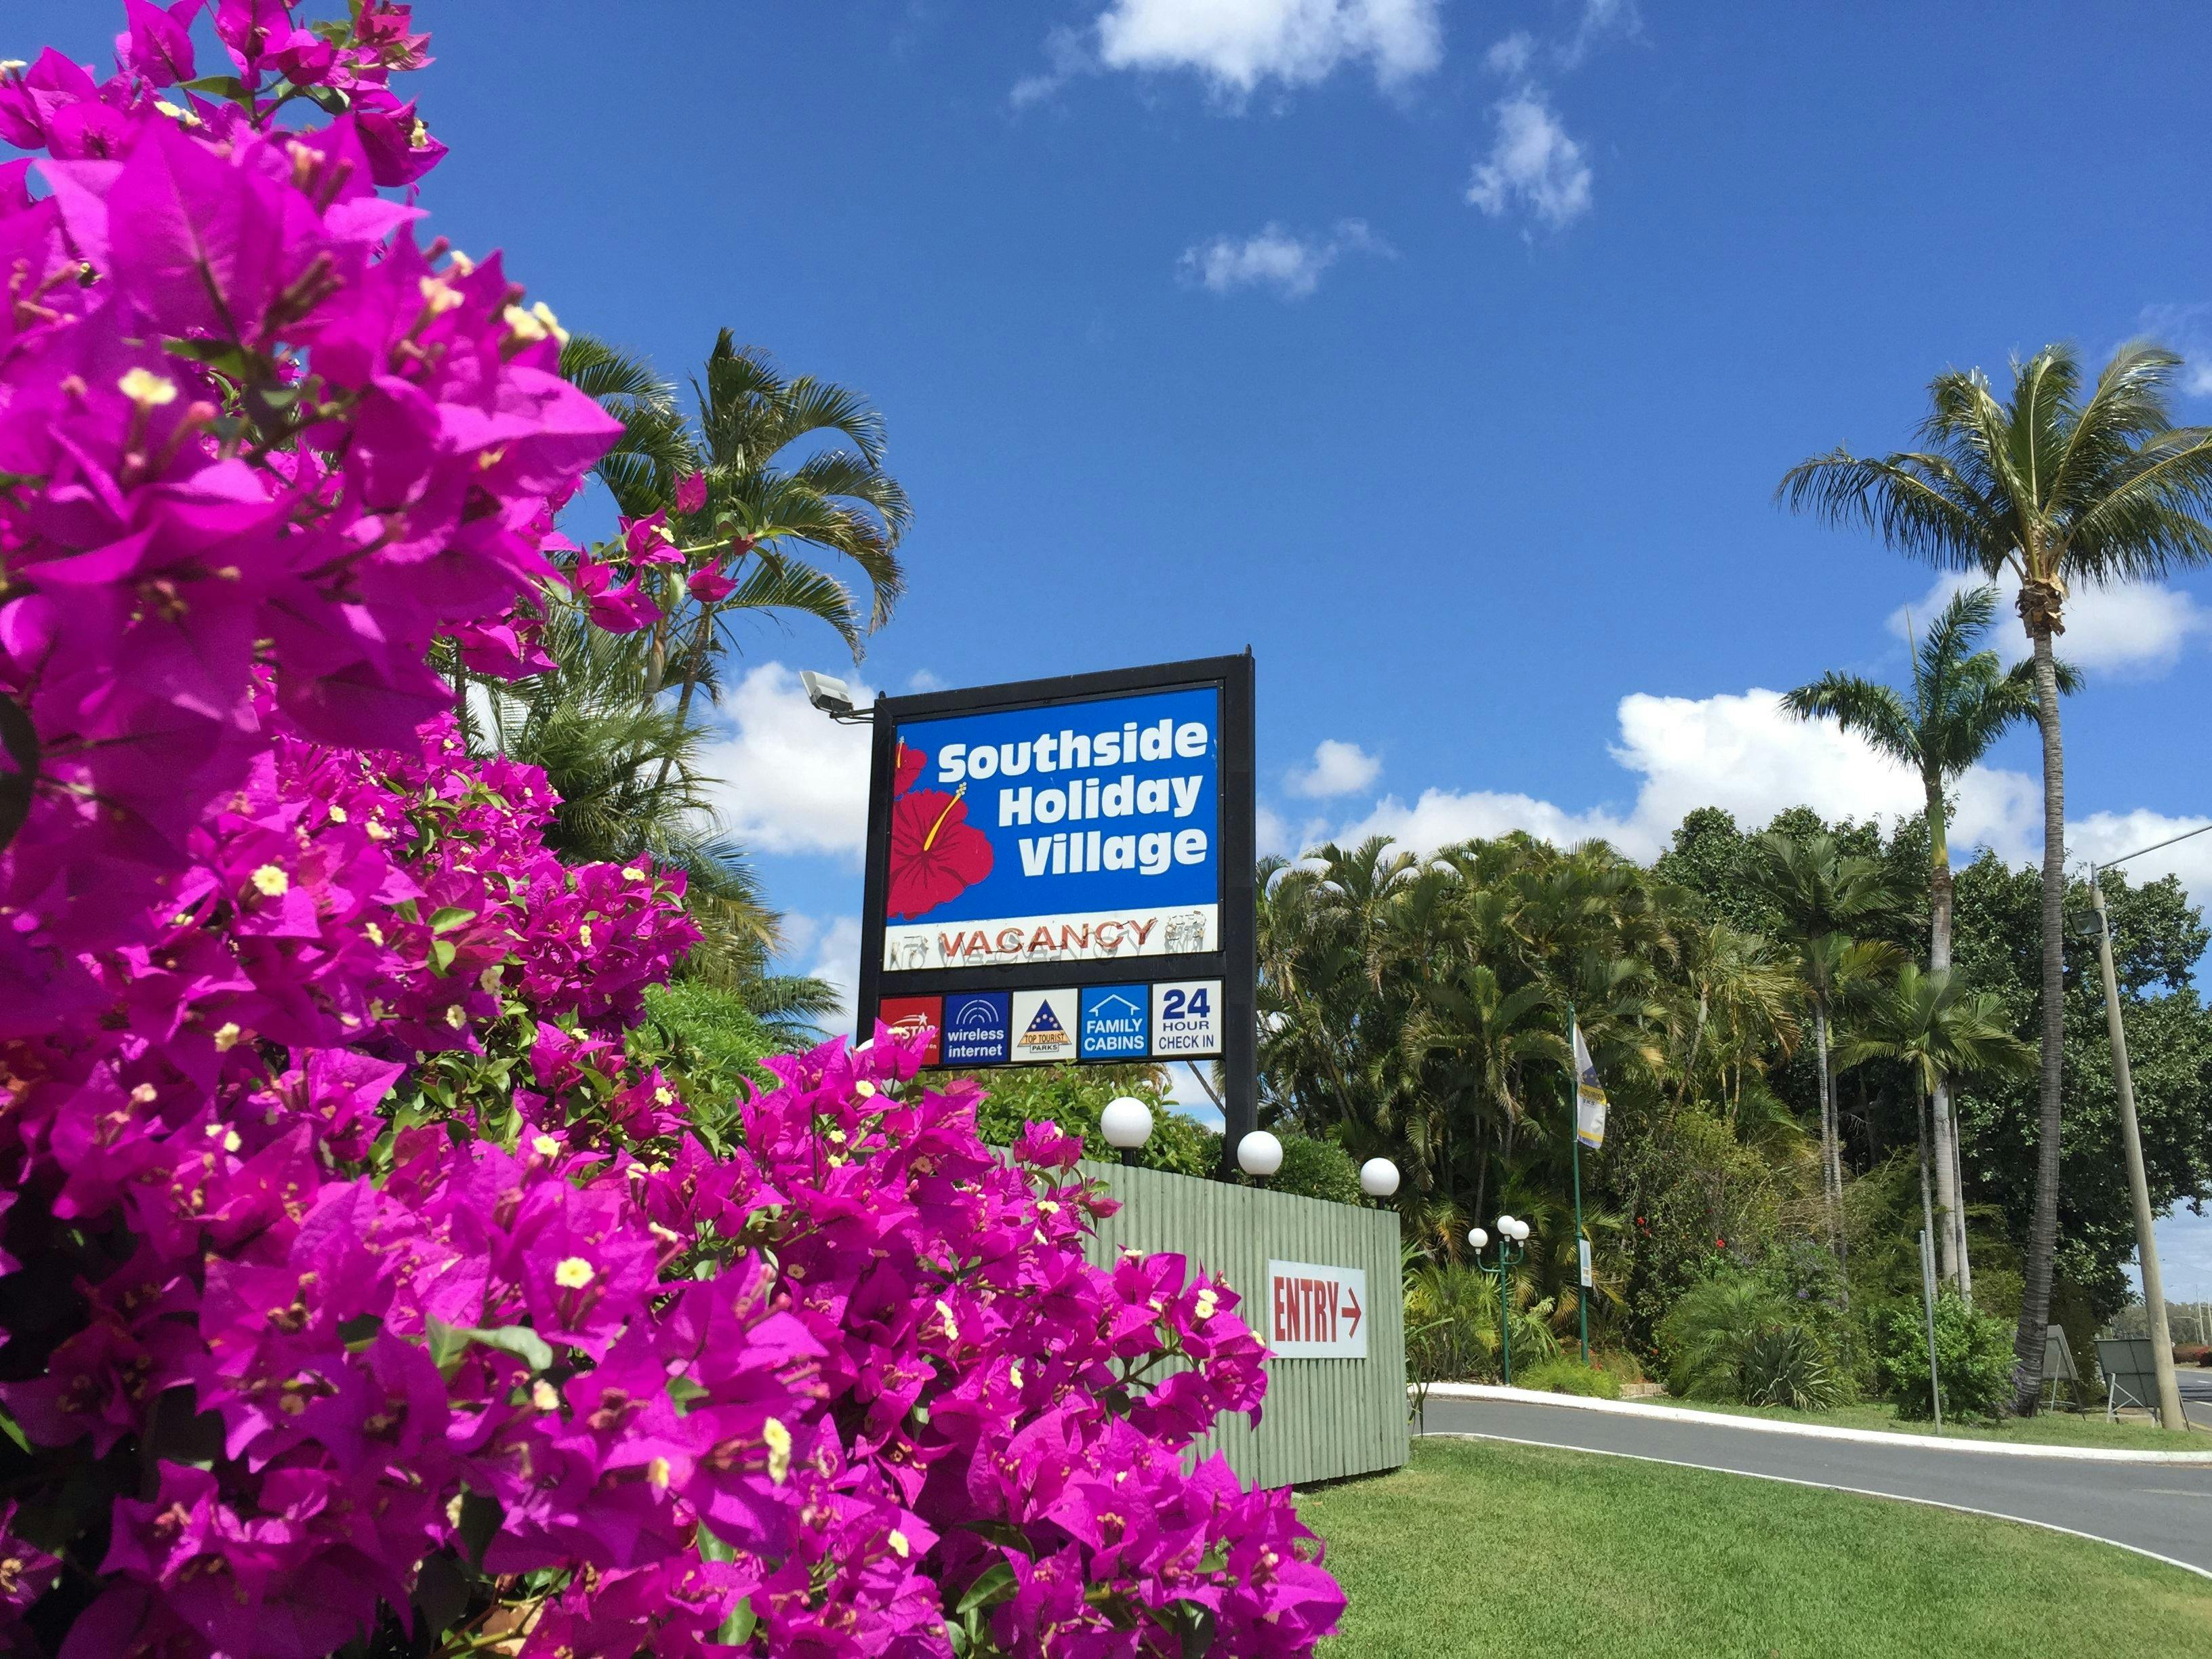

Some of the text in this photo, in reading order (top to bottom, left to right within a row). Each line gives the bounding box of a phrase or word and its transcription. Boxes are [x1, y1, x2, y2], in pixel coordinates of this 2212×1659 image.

[938, 718, 1208, 782] Southside
[999, 775, 1204, 827] Holiday
[1018, 828, 1208, 877] Village
[941, 918, 1158, 957] VACANCY
[1163, 988, 1210, 1020] 24
[1086, 1019, 1143, 1033] FAMILY
[1163, 1021, 1209, 1031] HOUR
[948, 1028, 1004, 1042] wireless
[1025, 1033, 1064, 1043] TOP TOURIST
[1084, 1035, 1145, 1051] CABINS
[1159, 1035, 1214, 1050] CHECK IN
[949, 1044, 1002, 1058] internet
[1274, 1276, 1339, 1343] ENTRY
